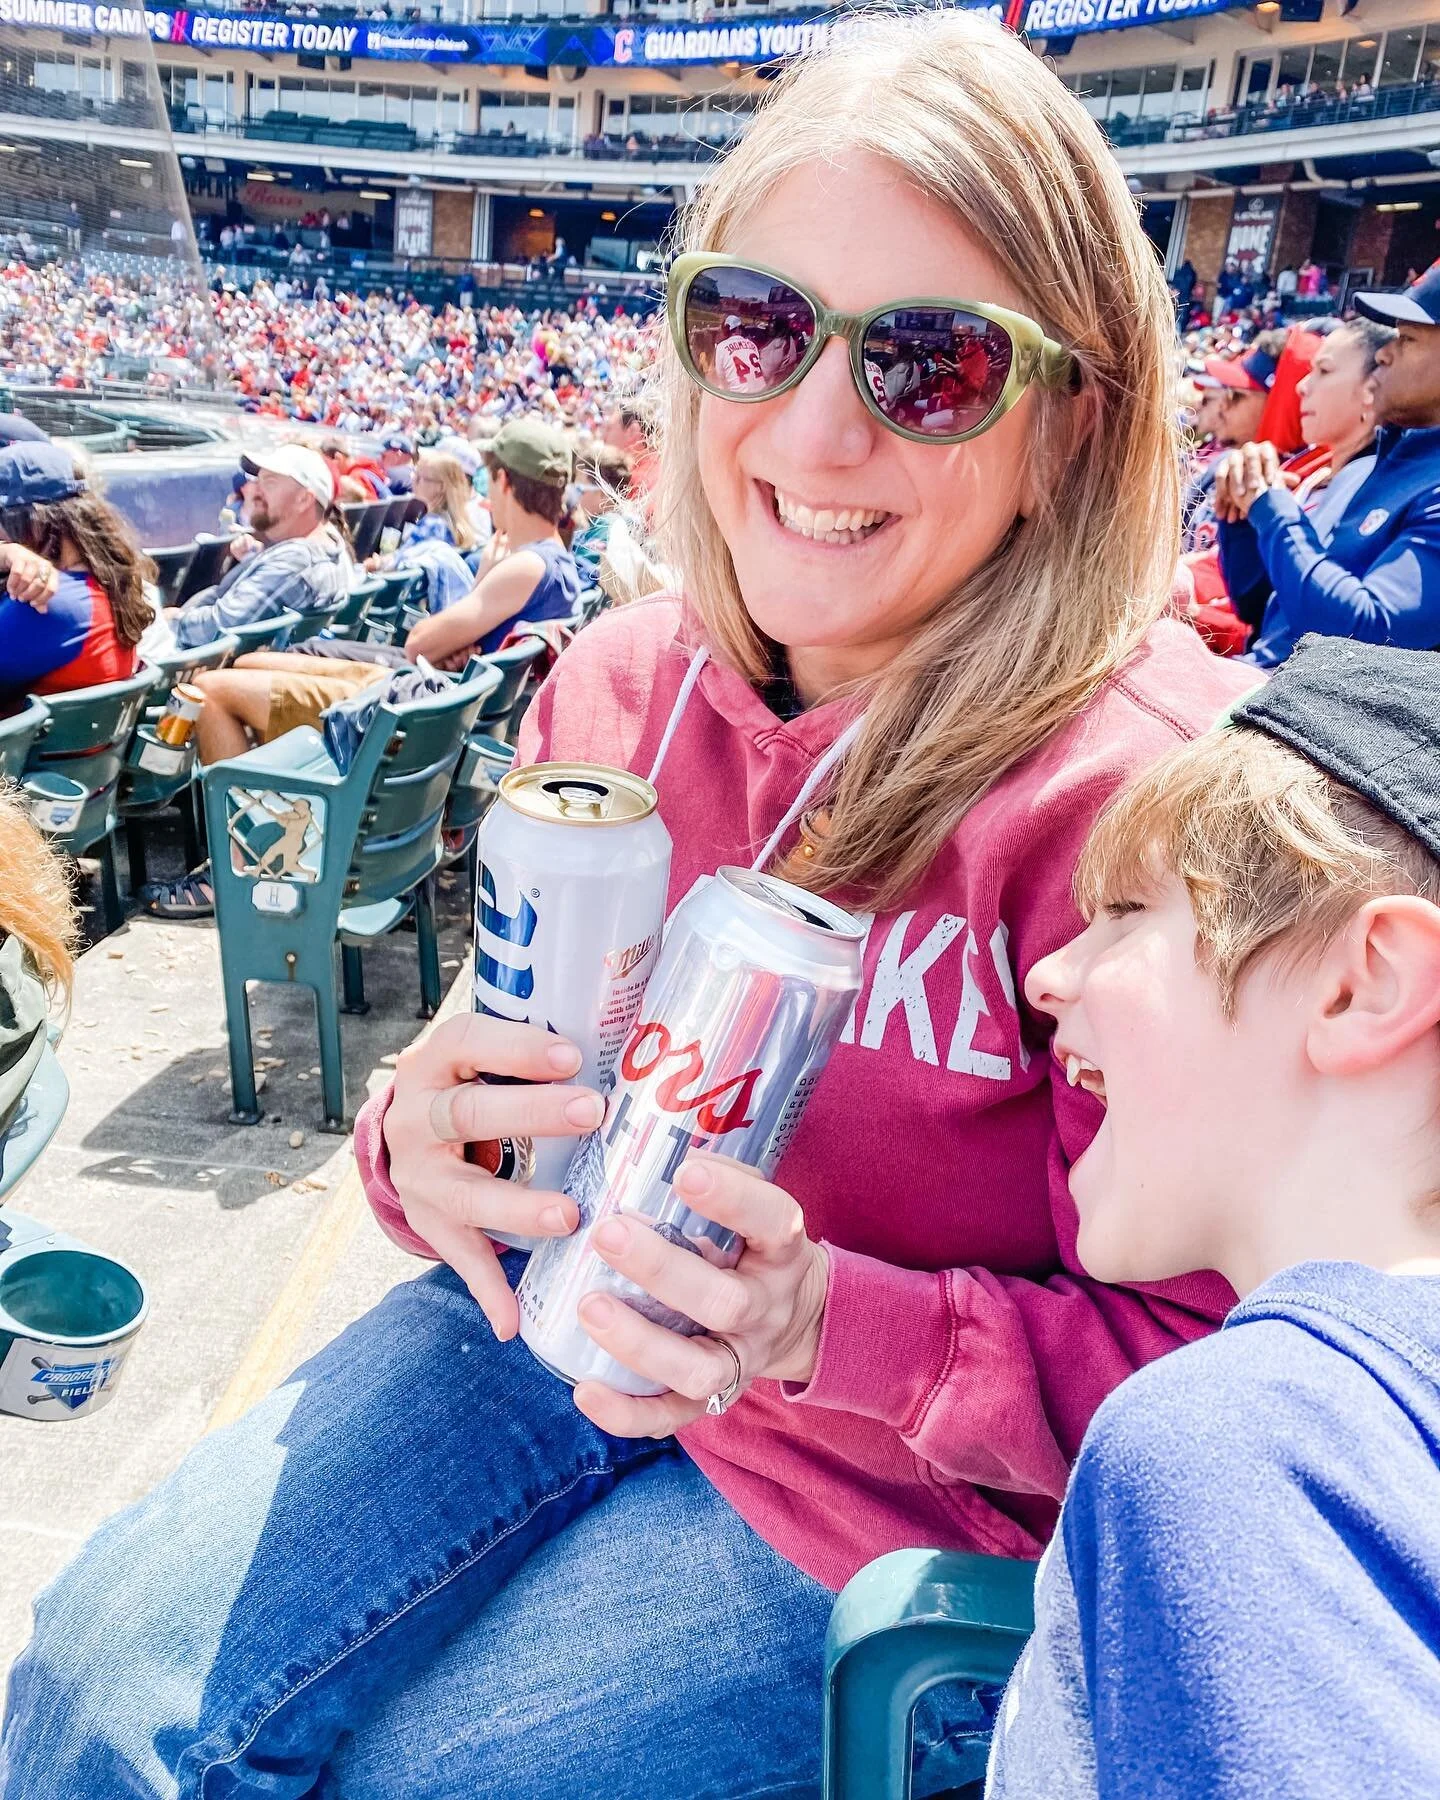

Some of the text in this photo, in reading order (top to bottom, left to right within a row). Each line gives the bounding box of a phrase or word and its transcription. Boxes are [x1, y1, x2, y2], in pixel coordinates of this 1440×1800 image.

[0, 0, 359, 51] SUMMER CAMPS REGISTER TODAY
[1024, 0, 1139, 30] REGISTER
[644, 26, 757, 60] GUARDIANS
[769, 1078, 807, 1153] LAGERED
